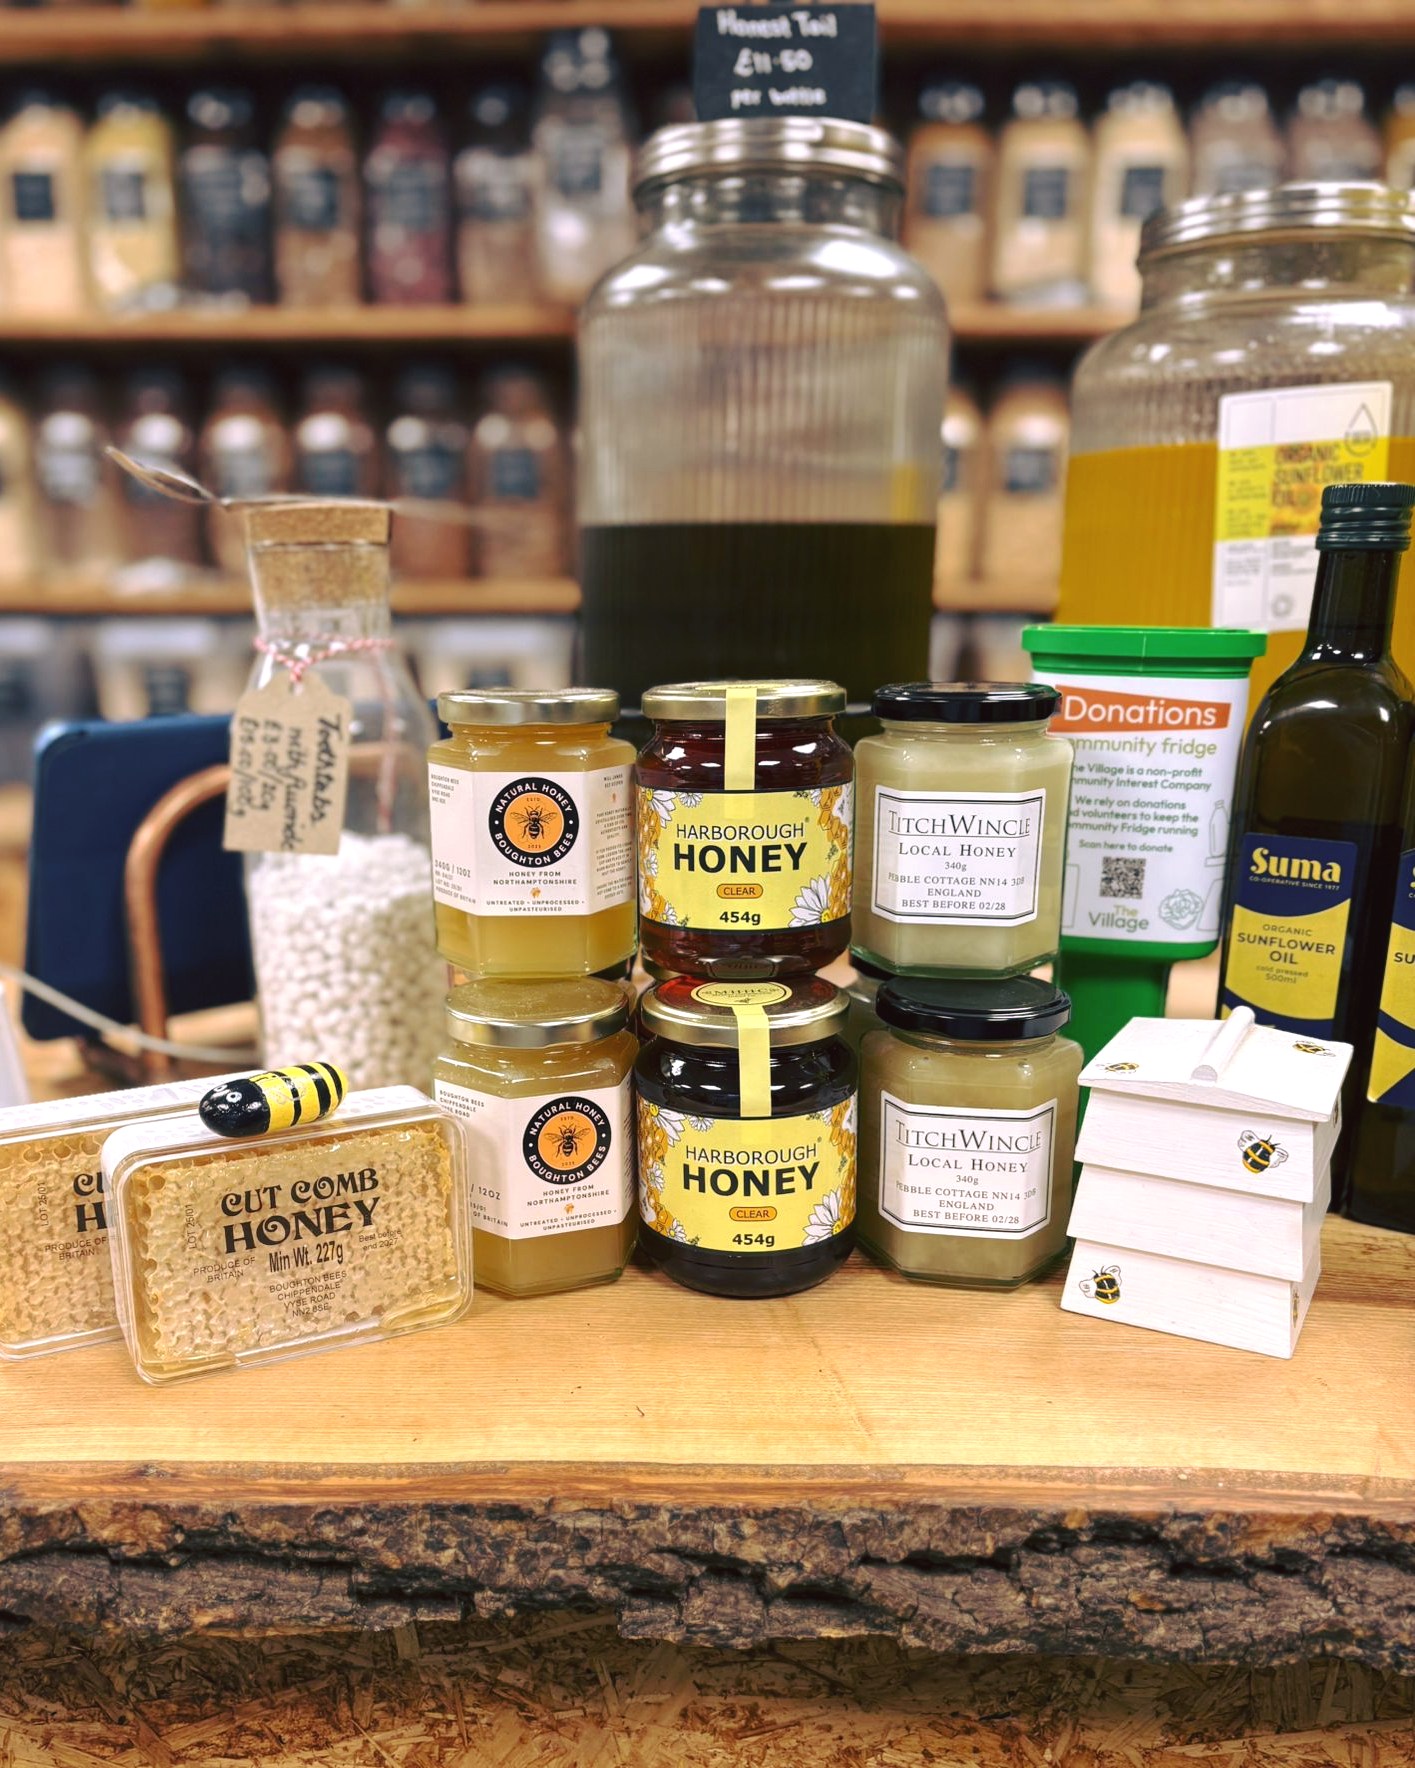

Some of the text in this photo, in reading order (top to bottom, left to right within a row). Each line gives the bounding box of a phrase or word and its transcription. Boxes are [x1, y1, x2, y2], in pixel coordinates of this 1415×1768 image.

[1063, 695, 1217, 726] Donations
[1068, 737, 1217, 759] ommunity fridge
[1087, 763, 1124, 776] Village
[1126, 764, 1134, 774] is
[1136, 767, 1144, 775] a
[1146, 767, 1203, 779] non-profit
[1116, 777, 1158, 789] Interest
[1160, 779, 1212, 792] Company
[494, 782, 573, 814] NATURAL HONEY
[1075, 795, 1186, 810] We rely on donations
[1082, 809, 1137, 820] volunteers
[1139, 811, 1150, 821] to
[1153, 812, 1179, 824] keep
[1182, 813, 1199, 823] the
[676, 822, 804, 841] HARBOROUGH
[1120, 822, 1156, 836] Fridge
[1158, 825, 1199, 837] running
[494, 832, 574, 867] BOUGHTON BEES
[899, 843, 1016, 858] LOCAL HONEY
[1079, 839, 1174, 853] Scan here to donate
[674, 842, 808, 874] HONEY
[1250, 847, 1342, 884] Suma
[945, 862, 967, 871] 340g
[924, 876, 976, 886] COTTAGE
[979, 878, 1007, 887] NN14
[1249, 875, 1300, 888] CO-OPERATIVE
[1301, 881, 1324, 890] SINCE
[723, 887, 756, 896] CLEAR
[927, 889, 982, 898] ENGLAND
[902, 900, 1006, 911] BEST BEFORE 02/28
[1113, 904, 1139, 917] The
[719, 911, 761, 926] 454g
[1088, 911, 1150, 933] Village
[1262, 924, 1313, 937] ORGANIC
[1237, 932, 1336, 956] SUNFLOWER
[1269, 950, 1299, 965] OIL
[1265, 972, 1298, 985] 500ml
[529, 1101, 606, 1136] NATURAL HONEY
[685, 1143, 817, 1165] HARBOROUGH
[528, 1145, 606, 1183] BOUGHTON BEES
[909, 1154, 1028, 1173] LOCAL HONEY
[683, 1162, 820, 1197] HONEY
[956, 1175, 979, 1186] 340g
[221, 1167, 379, 1217] CUT COMB
[527, 1189, 610, 1206] NORTHAMPTONSHIRE
[543, 1184, 595, 1197] HONEY FROM
[935, 1187, 988, 1199] COTTAGE
[992, 1191, 1020, 1200] NN14
[939, 1200, 994, 1211] ENGLAND
[520, 1209, 612, 1228] UNTREATED UNPROCESSED
[736, 1210, 770, 1219] CLEAR
[913, 1209, 1020, 1224] BEST BEFORE 02/28
[223, 1196, 381, 1254] HONEY
[543, 1219, 595, 1231] UNPASTEURISED
[187, 1230, 198, 1250] LOT
[358, 1229, 402, 1243] Best before
[732, 1234, 775, 1247] 454g
[45, 1236, 108, 1252] PRODUCE OF
[362, 1243, 378, 1251] end
[58, 1248, 95, 1261] BRITAIN
[268, 1240, 344, 1273] Min Wt. 227g
[193, 1256, 256, 1277] PRODUCE OF
[207, 1269, 244, 1283] BRITAIN
[269, 1270, 347, 1293] BOUGHTON BEES
[277, 1281, 342, 1301] CHIPPENDALE
[284, 1292, 336, 1311] VYSE ROAD
